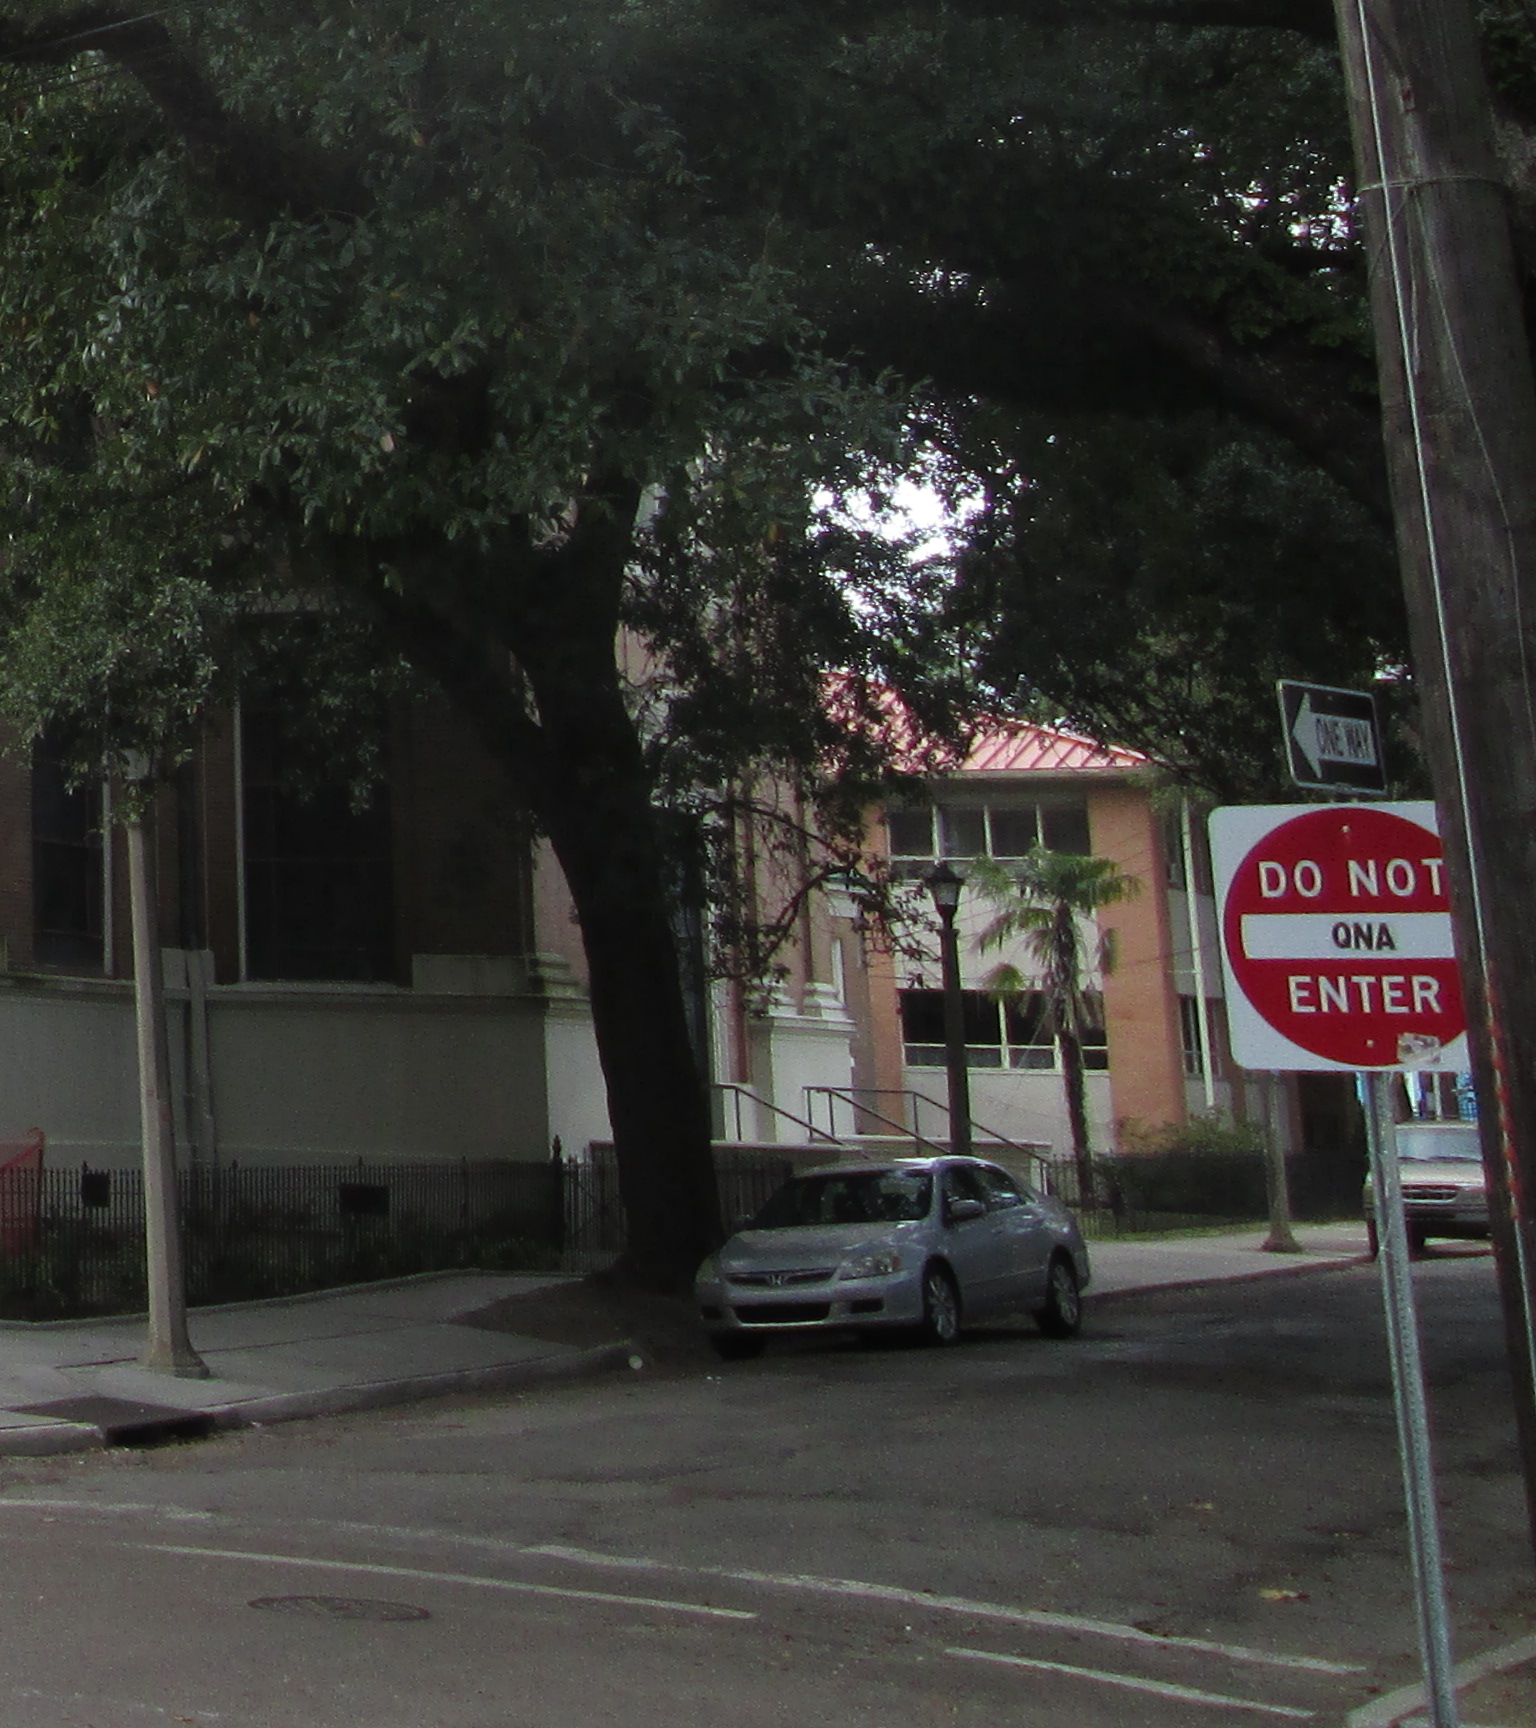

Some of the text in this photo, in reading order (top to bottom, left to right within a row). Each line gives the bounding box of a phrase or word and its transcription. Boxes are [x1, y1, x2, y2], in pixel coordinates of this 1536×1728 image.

[1315, 718, 1371, 759] ONE WAY
[1258, 858, 1444, 899] DO NOT
[1287, 975, 1443, 1014] ENTER
